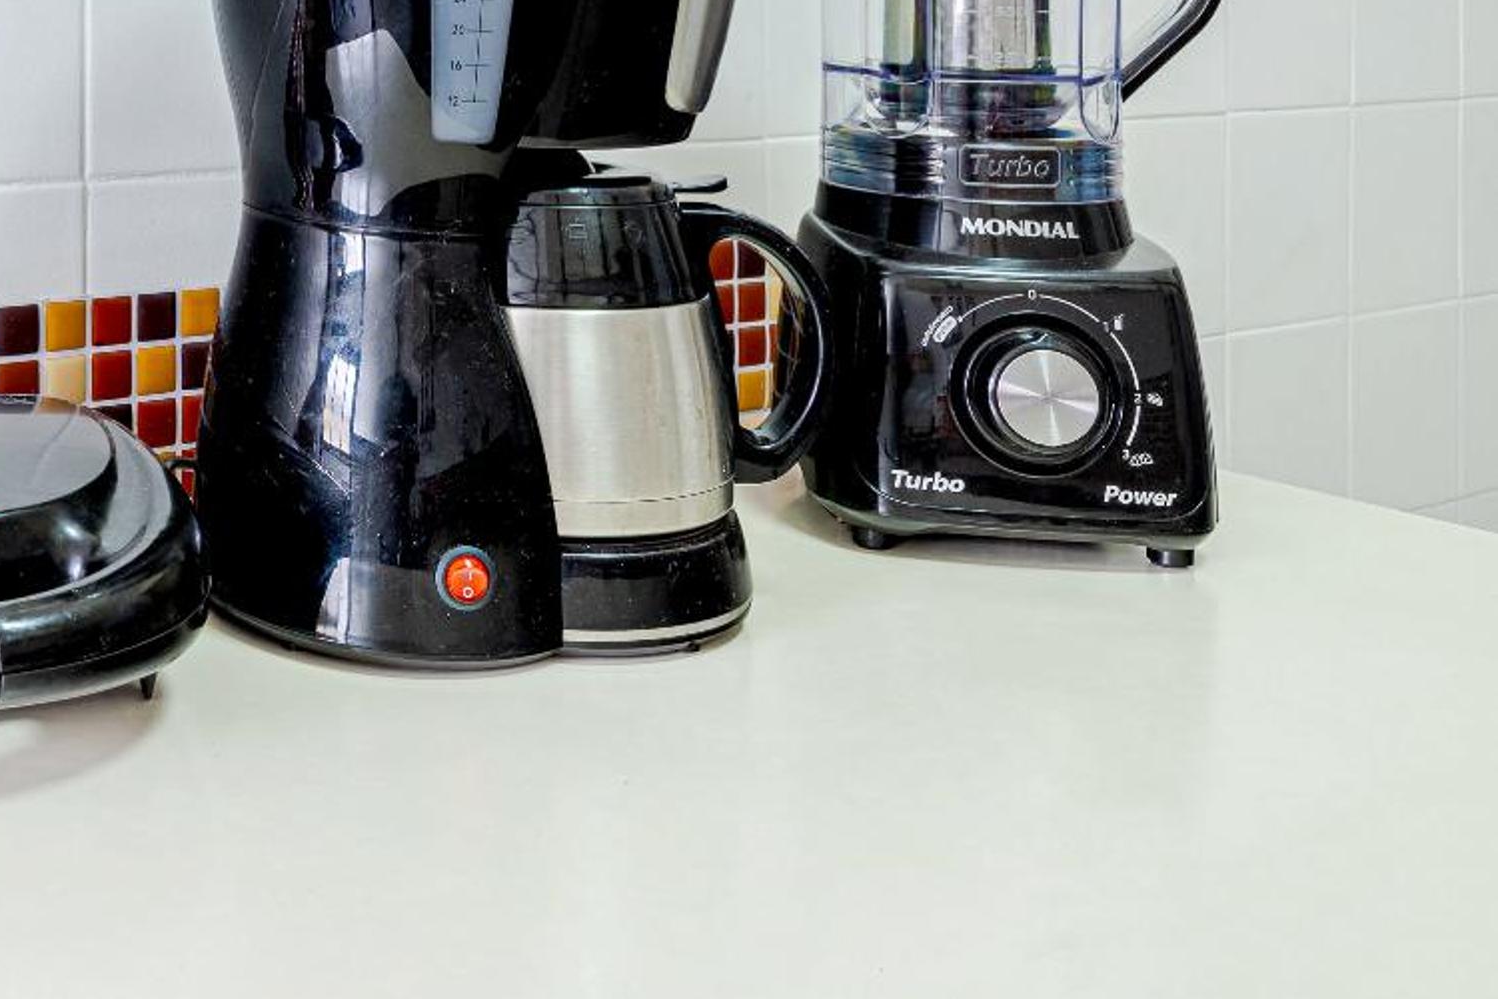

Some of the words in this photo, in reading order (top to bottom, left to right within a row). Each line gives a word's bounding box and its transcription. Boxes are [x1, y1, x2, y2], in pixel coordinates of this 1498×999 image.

[450, 60, 463, 71] 16
[970, 153, 1051, 179] Turbo
[960, 216, 1080, 239] MONDIAL
[890, 469, 966, 493] Turbo
[1104, 485, 1178, 507] Power
